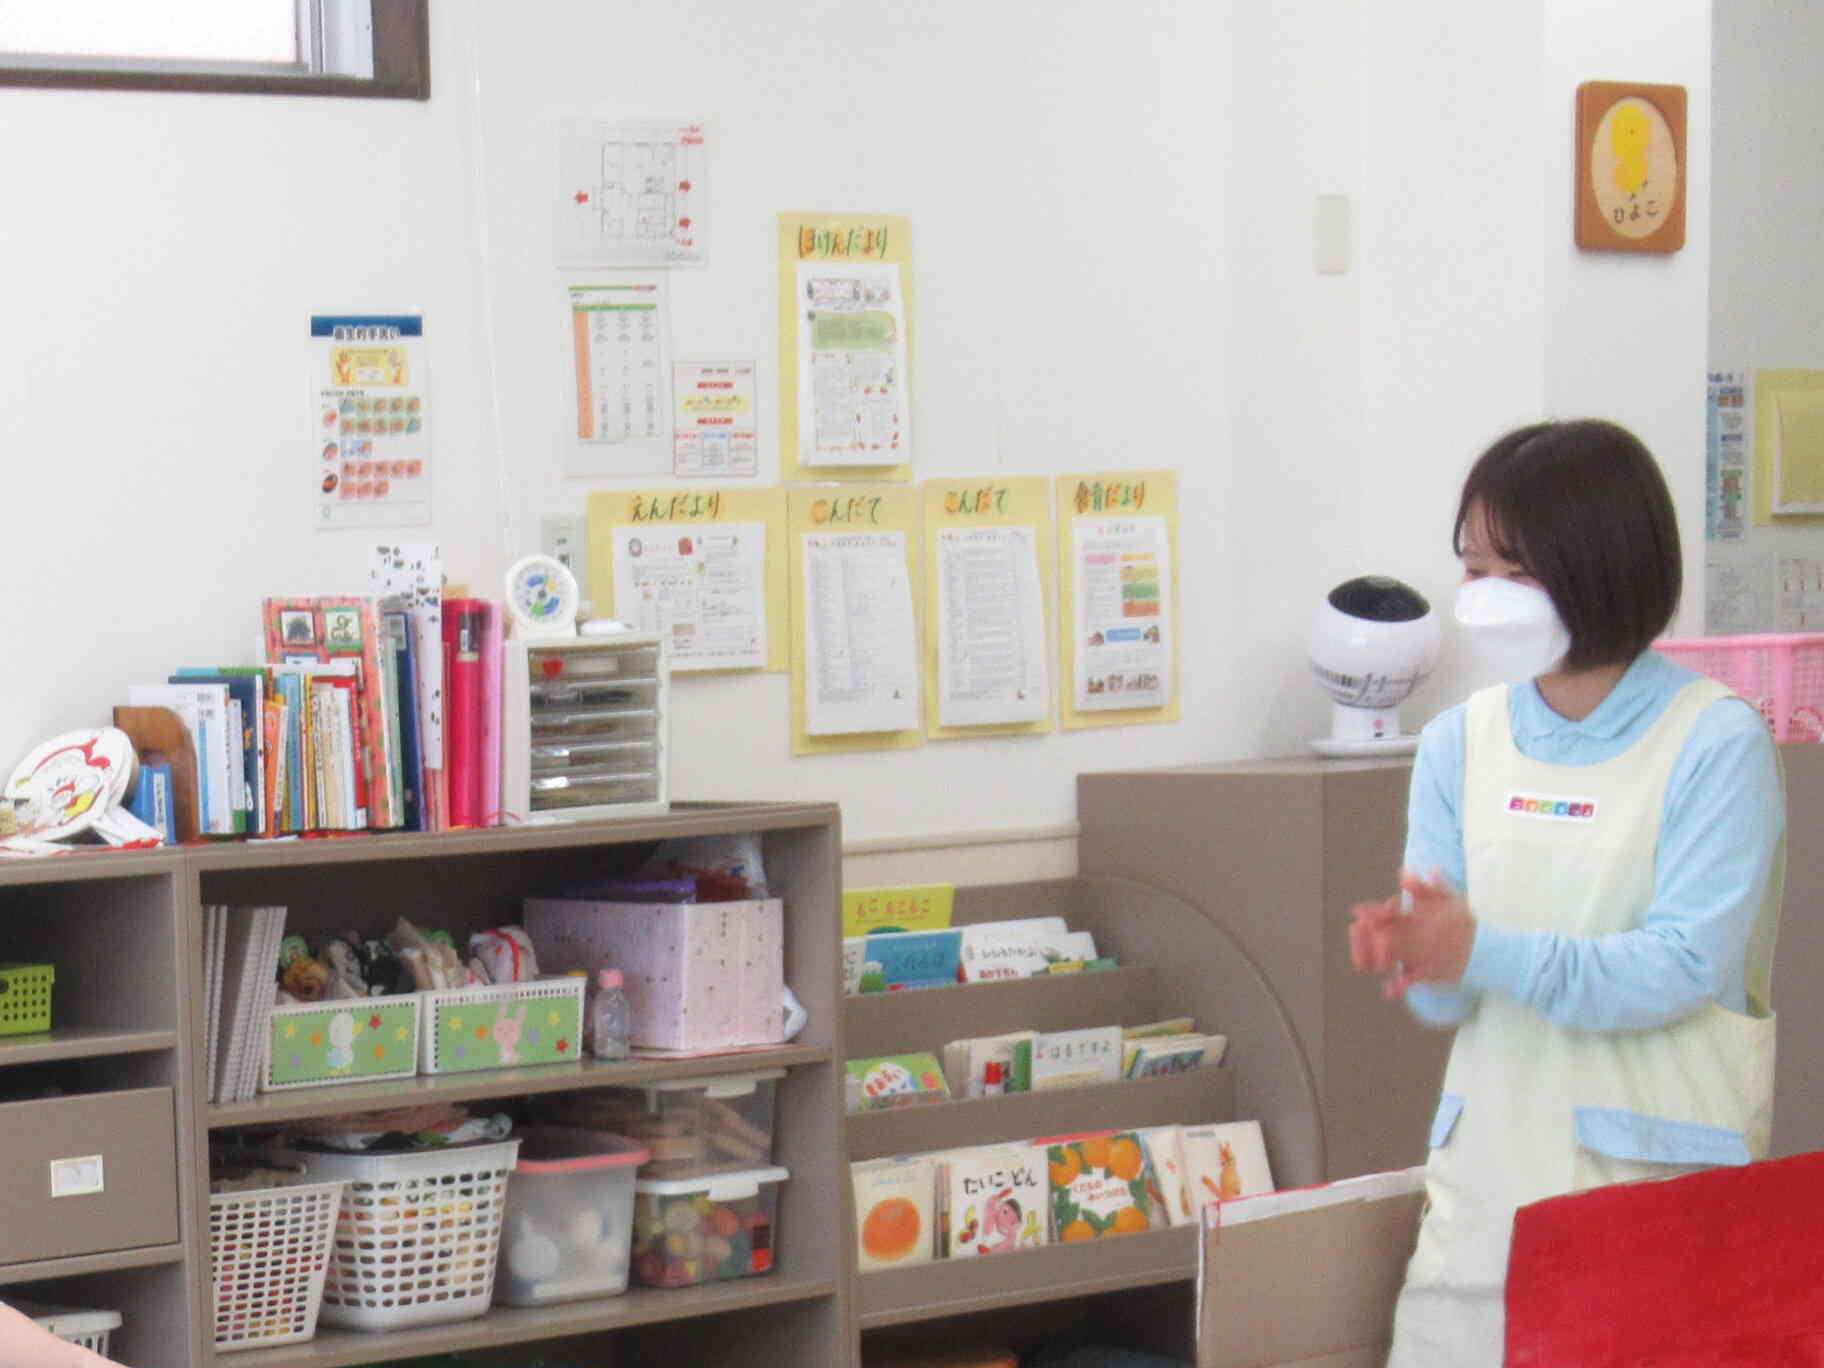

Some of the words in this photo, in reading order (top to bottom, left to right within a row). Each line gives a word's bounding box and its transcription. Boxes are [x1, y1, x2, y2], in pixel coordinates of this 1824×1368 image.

[798, 224, 888, 259] ほけんだより
[632, 490, 720, 522] えんだより
